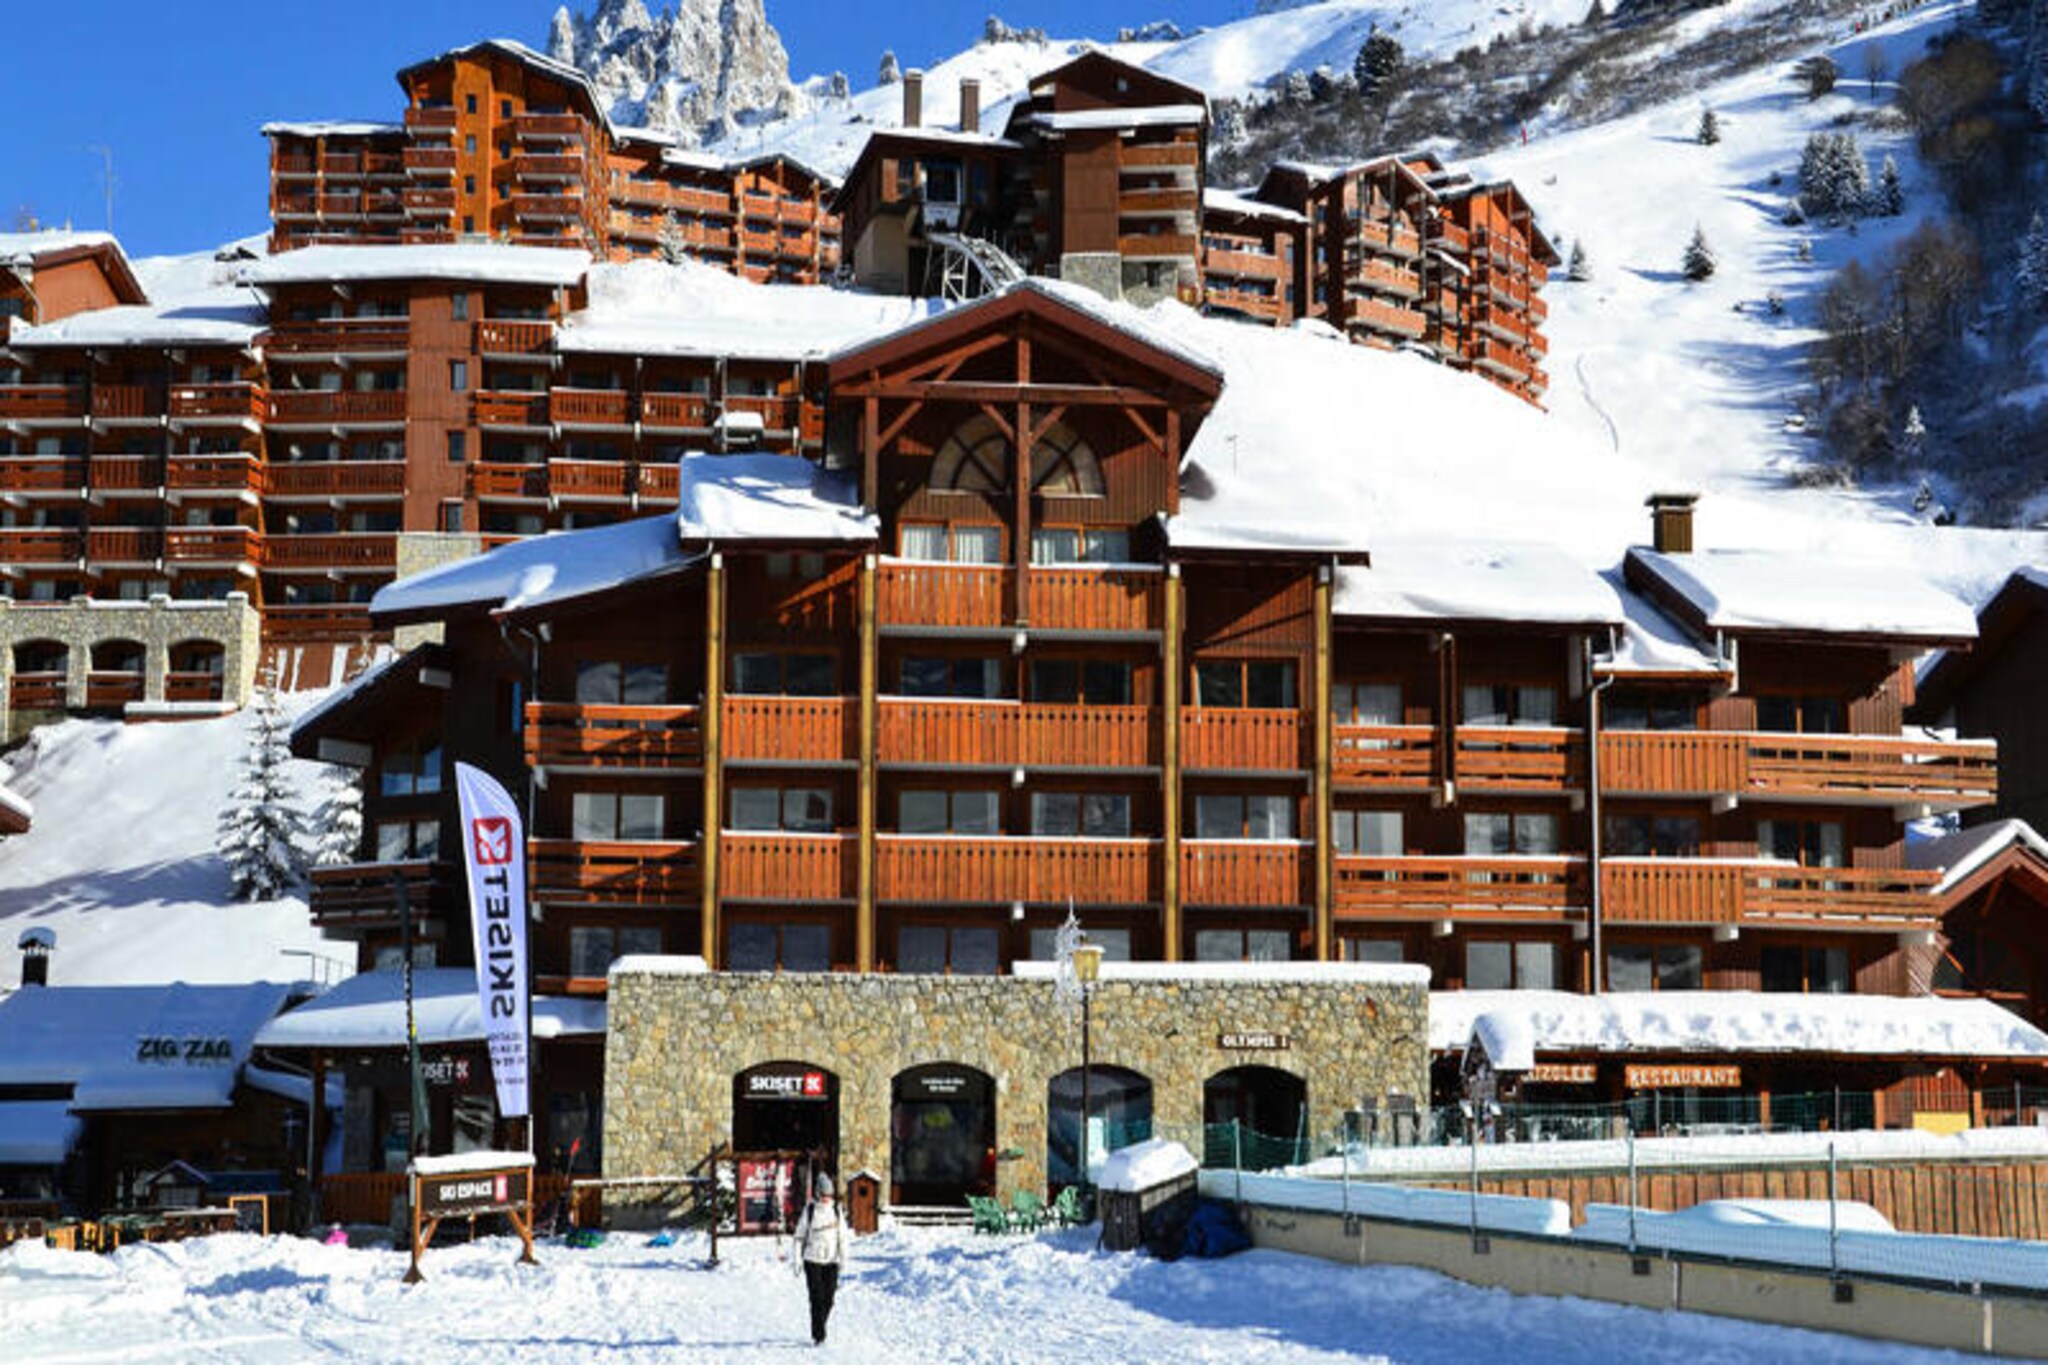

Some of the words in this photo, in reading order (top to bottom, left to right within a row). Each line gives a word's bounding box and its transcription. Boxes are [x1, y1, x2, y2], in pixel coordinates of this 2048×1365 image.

[138, 1038, 178, 1061] ZIG
[750, 1075, 803, 1091] SKISET
[1628, 1067, 1738, 1089] RESTAURANT
